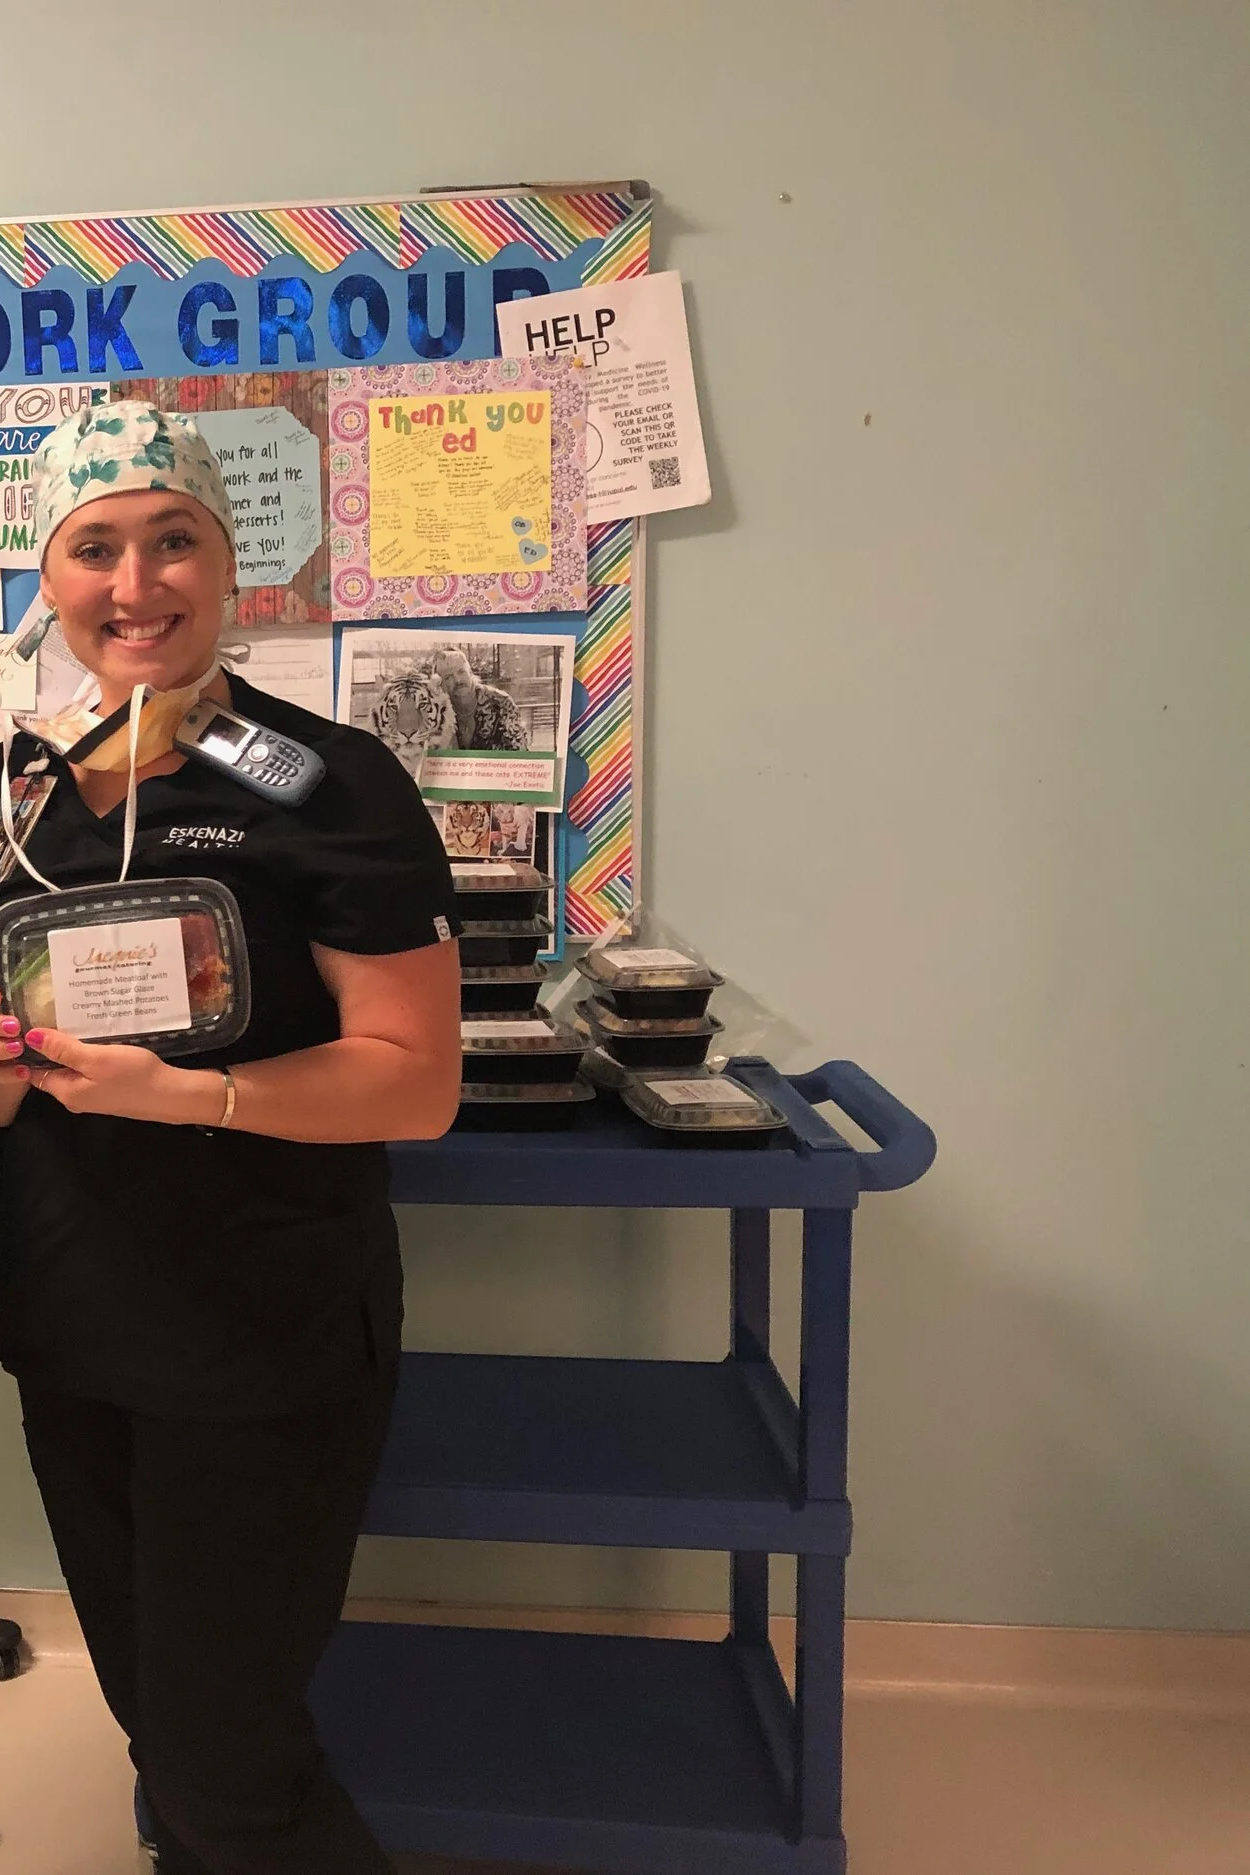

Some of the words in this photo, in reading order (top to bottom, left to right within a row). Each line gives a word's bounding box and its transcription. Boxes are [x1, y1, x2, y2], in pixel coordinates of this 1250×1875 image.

[525, 308, 616, 352] HELP
[645, 369, 667, 377] better
[638, 384, 670, 396] COVID-19
[486, 402, 545, 432] you
[615, 408, 643, 418] PLEASE
[646, 403, 673, 414] CHECK
[613, 418, 635, 428] YOUR
[637, 416, 660, 424] EMAIL
[621, 427, 642, 436] SCAN
[644, 424, 662, 433] THIS
[664, 422, 675, 430] QR
[442, 427, 477, 454] ed
[620, 436, 642, 446] CODE
[657, 431, 677, 440] TAKE
[628, 444, 645, 454] THE
[647, 440, 678, 452] WEEKLY
[216, 448, 234, 467] you
[239, 445, 256, 459] for
[261, 442, 278, 459] all
[613, 455, 643, 466] SURVEY
[223, 471, 251, 487] work
[258, 468, 278, 483] and
[284, 468, 303, 481] the
[260, 492, 281, 506] and
[233, 510, 284, 530] desserts!
[236, 542, 250, 554] VE
[257, 537, 285, 556] YOU!
[240, 558, 286, 572] Beginnings
[169, 827, 245, 842] ESKENAZI
[75, 965, 111, 973] gourmet
[69, 977, 112, 988] Homemade
[115, 973, 149, 983] Meatloaf
[151, 972, 168, 980] with
[110, 987, 131, 996] Sugar
[103, 999, 133, 1007] Mashed
[135, 995, 169, 1004] Potatoes
[87, 1012, 107, 1020] Fresh
